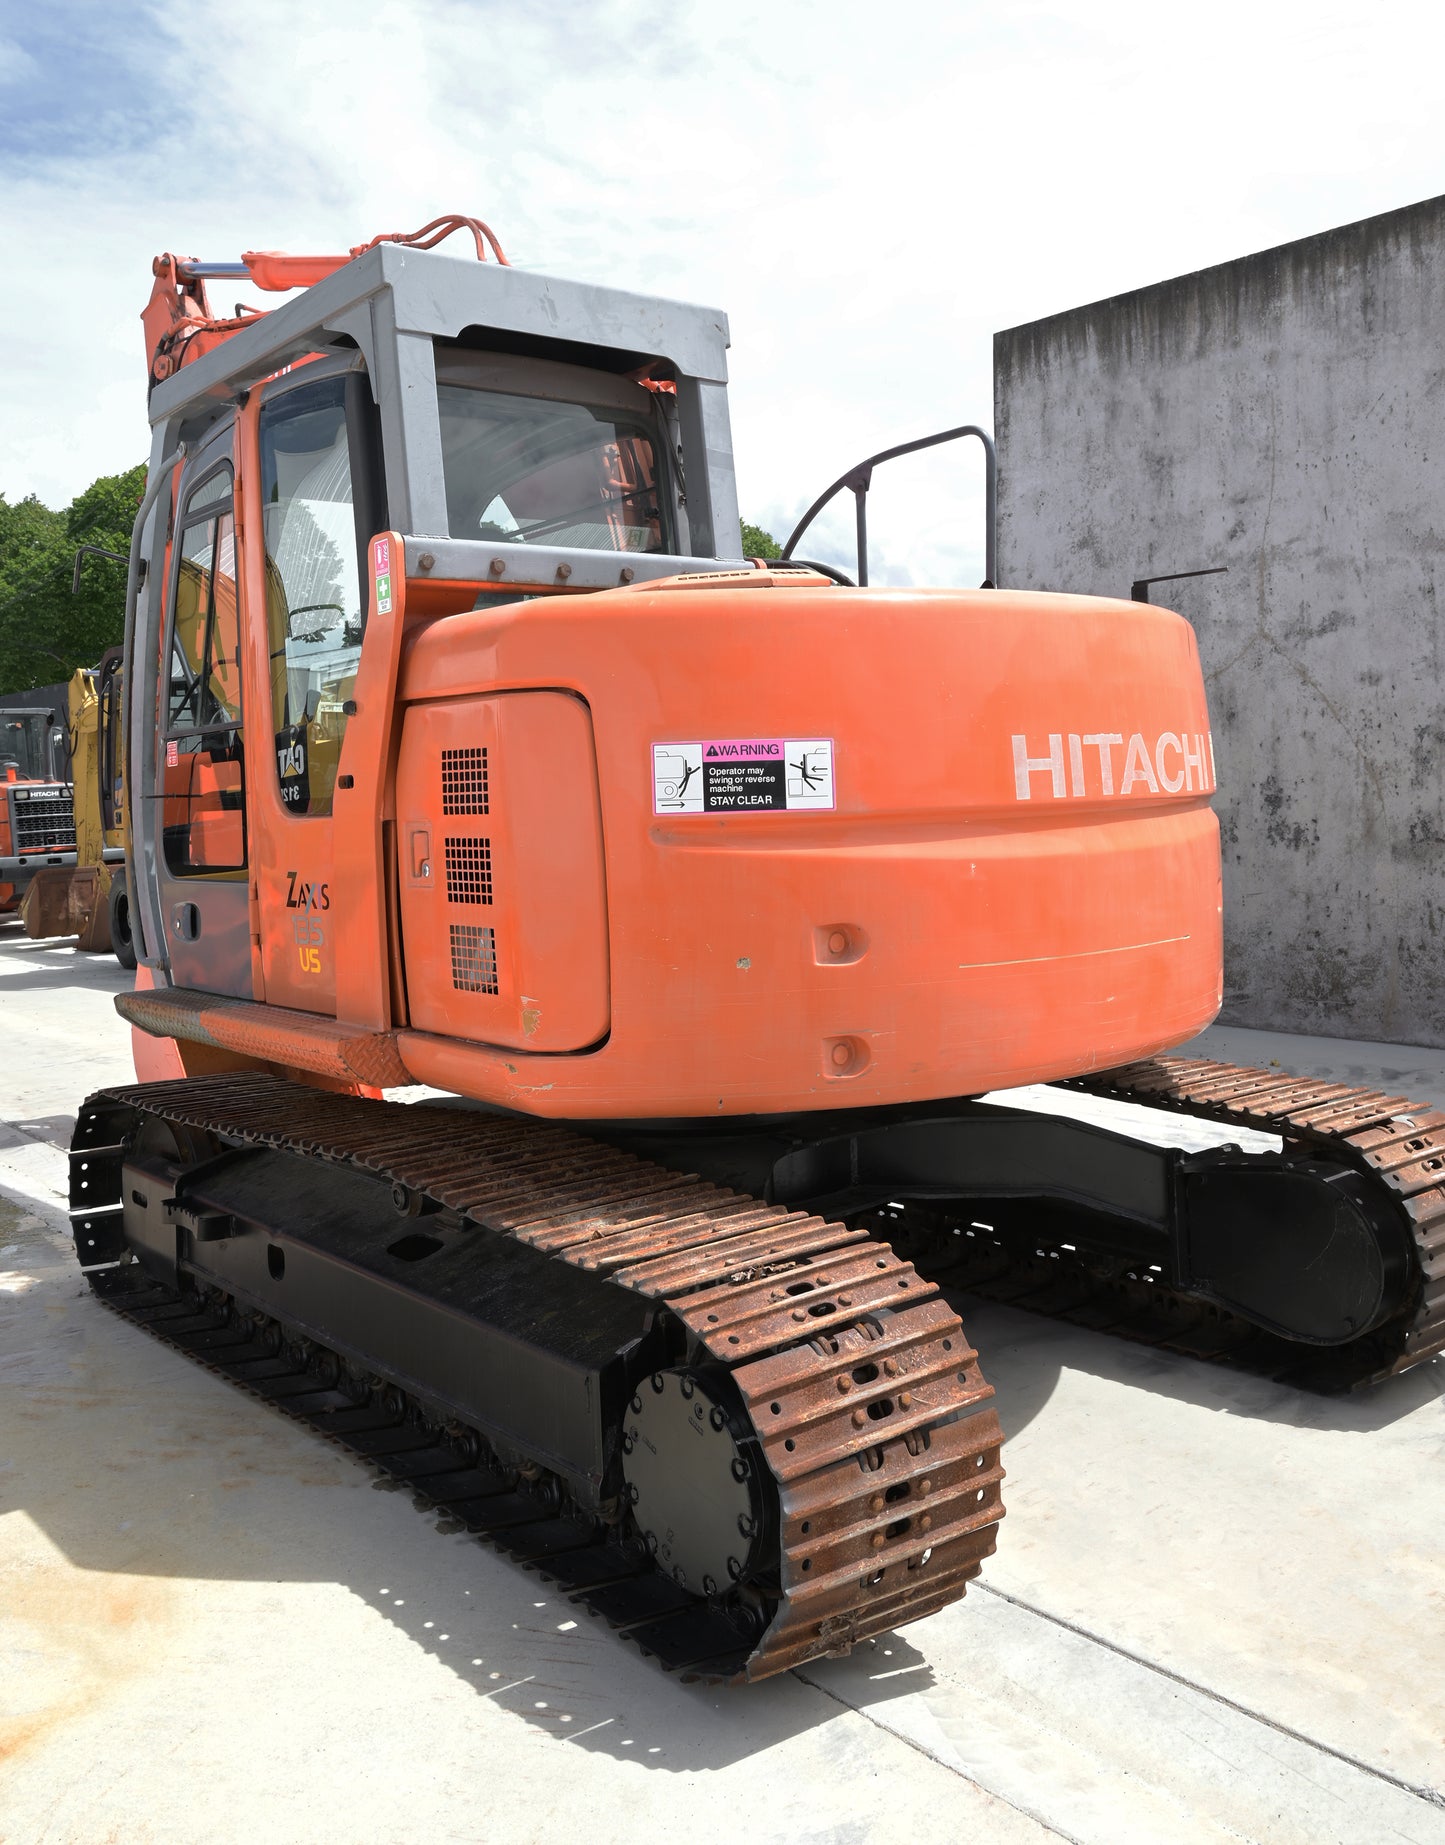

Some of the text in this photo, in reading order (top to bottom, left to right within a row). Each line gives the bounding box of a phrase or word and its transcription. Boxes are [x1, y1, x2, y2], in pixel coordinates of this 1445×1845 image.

[718, 744, 779, 756] WARNING
[709, 767, 746, 776] Operator
[1011, 732, 1209, 800] HITACHI
[709, 776, 733, 785] swing
[709, 785, 743, 793] machine
[710, 795, 773, 806] STAY CLEAR
[291, 915, 324, 946] 135
[299, 947, 321, 973] US
